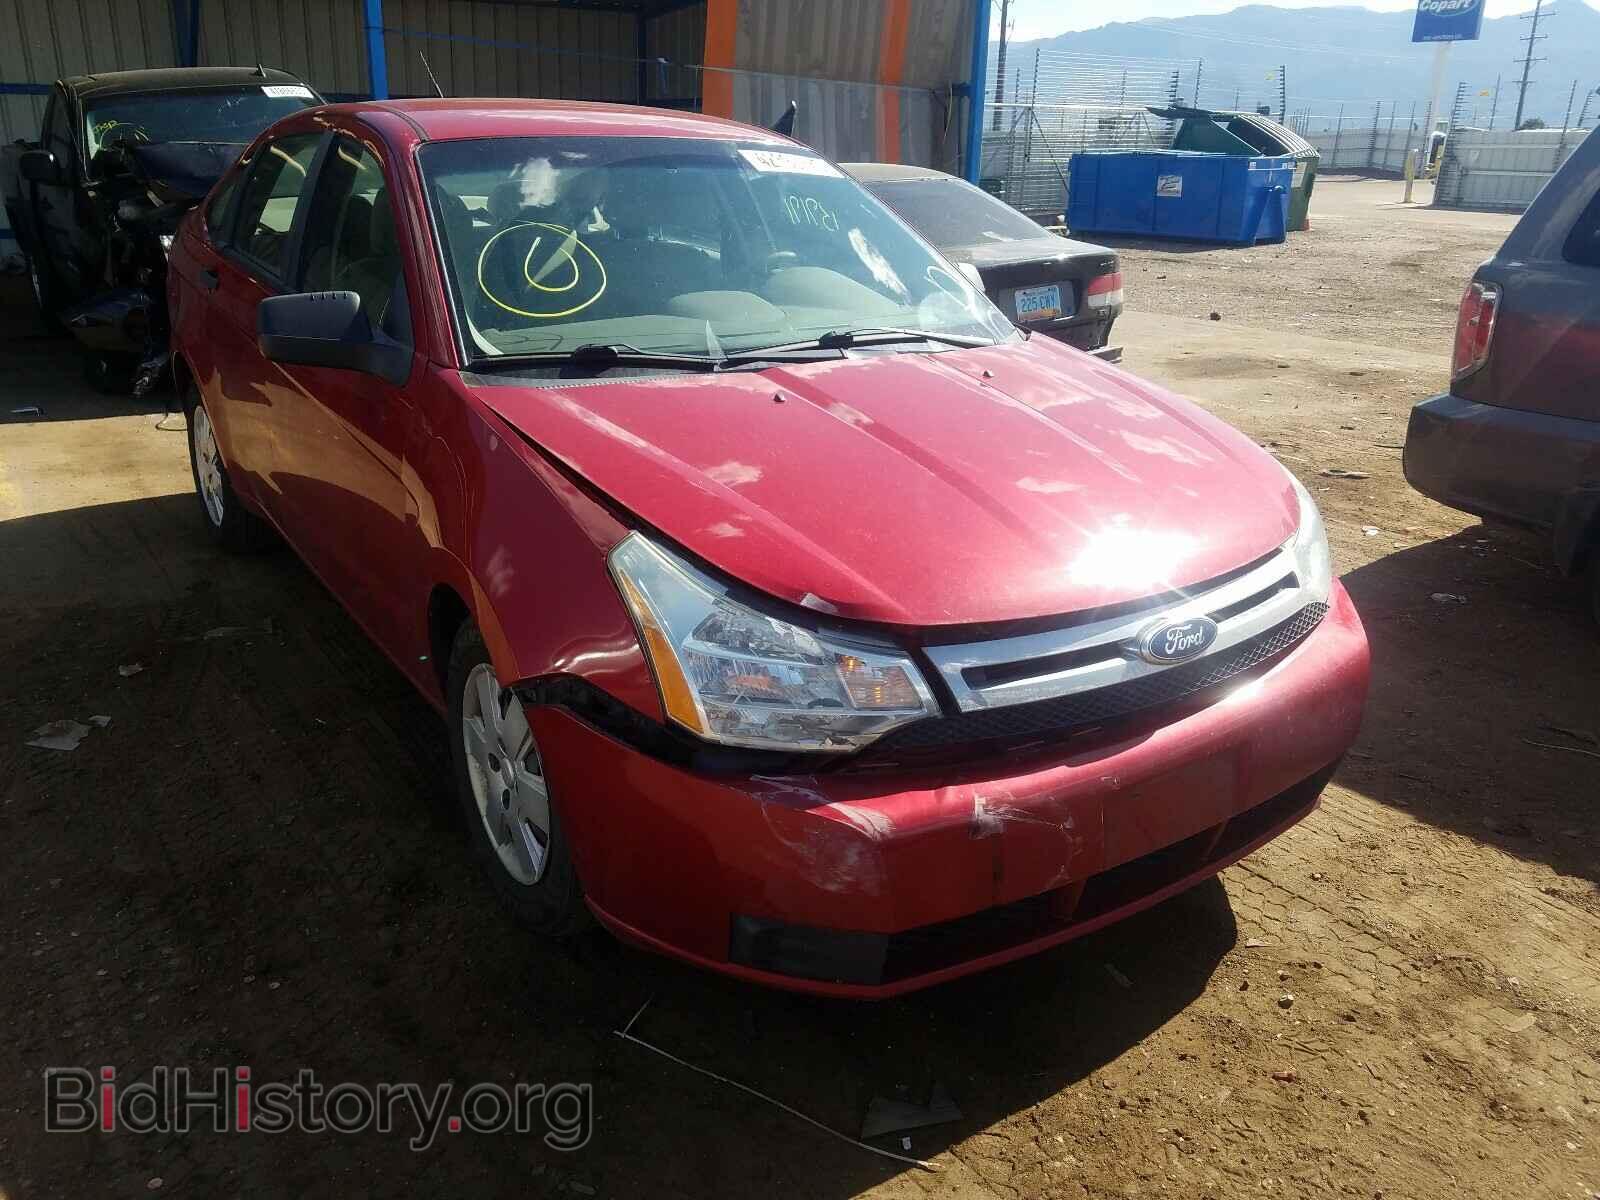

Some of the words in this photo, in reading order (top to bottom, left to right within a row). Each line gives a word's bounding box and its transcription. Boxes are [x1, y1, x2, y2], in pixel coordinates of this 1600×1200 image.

[1419, 0, 1472, 13] Copart
[1020, 296, 1038, 312] 225
[1165, 624, 1204, 654] Ford
